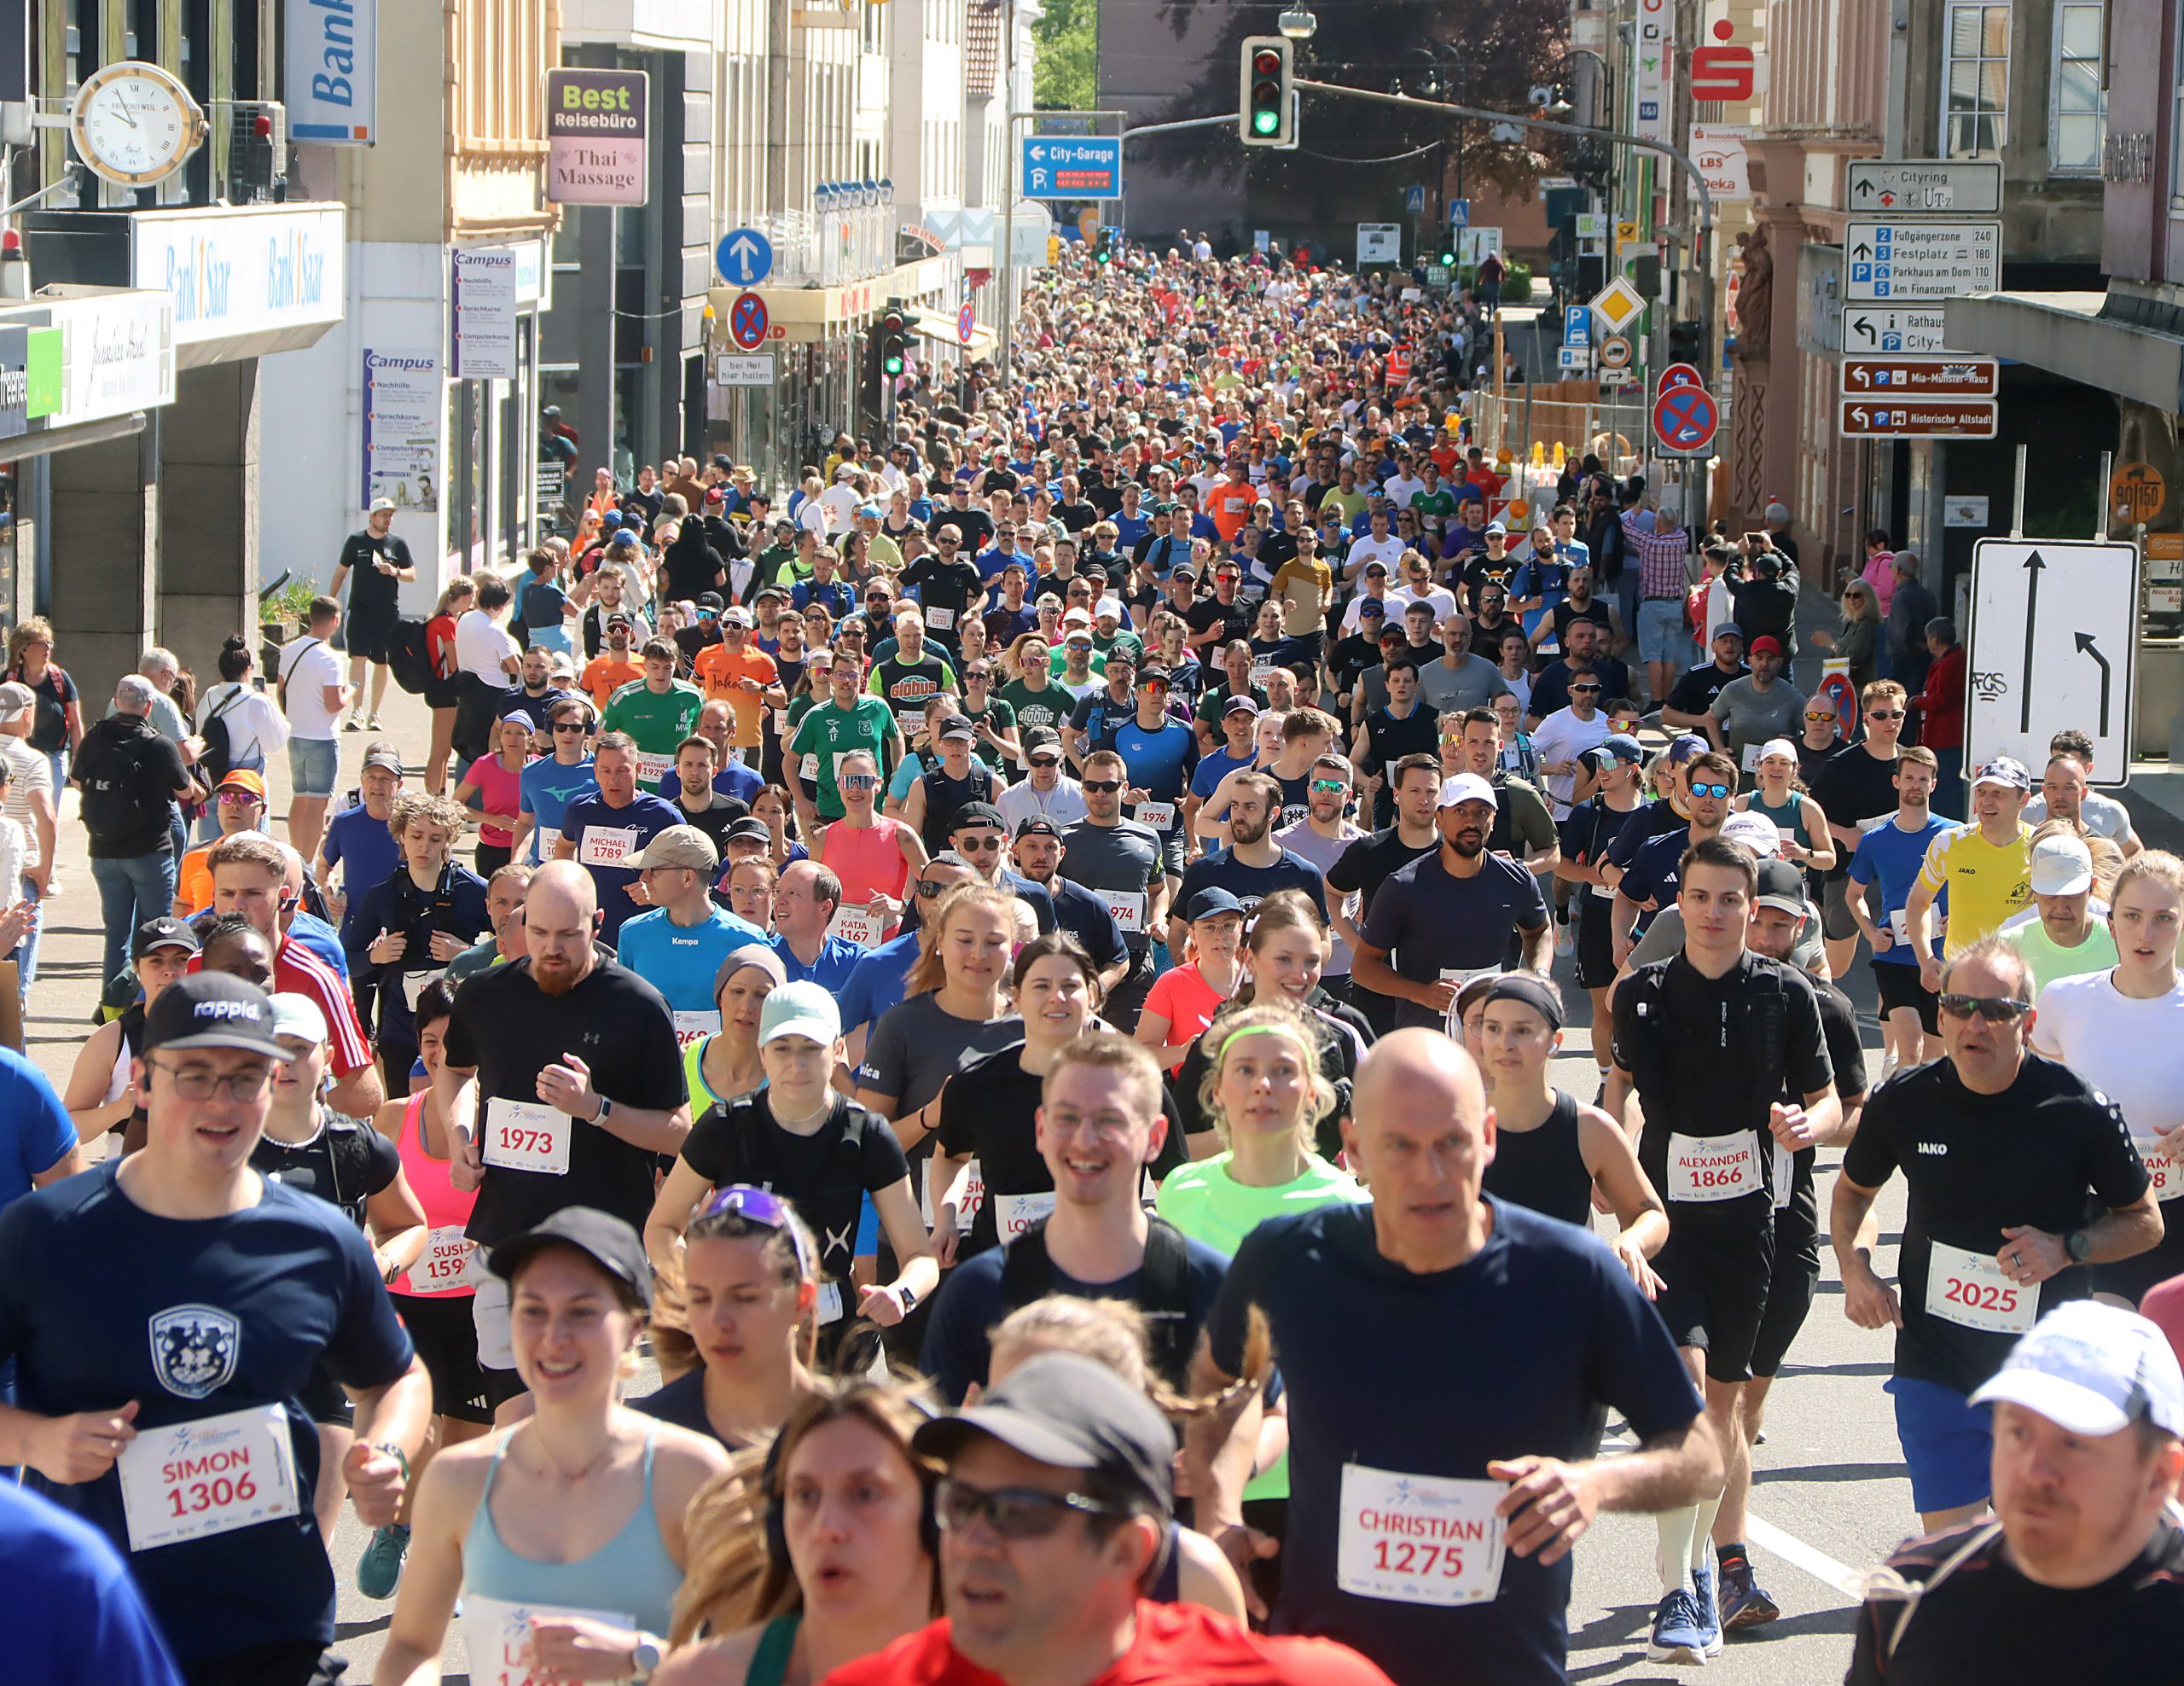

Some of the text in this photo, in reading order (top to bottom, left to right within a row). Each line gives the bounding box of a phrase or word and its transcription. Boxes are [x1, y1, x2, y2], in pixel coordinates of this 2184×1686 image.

[563, 85, 630, 110] Best
[141, 102, 155, 111] WEIL
[555, 113, 636, 129] Reisebüro
[575, 150, 616, 166] Thai
[1050, 146, 1113, 163] City-Garage
[1700, 158, 1723, 168] LBS
[558, 168, 636, 189] Massage
[1902, 172, 1948, 184] Cityring
[907, 226, 920, 235] EIS
[1894, 230, 1961, 244] Fußgängerzone
[1974, 231, 1991, 242] 240
[455, 254, 512, 268] Campus
[1894, 248, 1949, 260] Festplatz
[1975, 248, 1990, 259] 180
[268, 227, 294, 309] Bank
[301, 232, 323, 305] Saar
[1893, 267, 1935, 277] Parkhaus
[1937, 269, 1949, 277] am
[1951, 267, 1971, 277] Dom
[1976, 267, 1989, 277] 110
[166, 235, 196, 323] Bank
[206, 240, 230, 319] Saar
[1893, 285, 1908, 294] Am
[1912, 284, 1956, 294] Finanzamt
[1908, 334, 1945, 350] City-
[368, 354, 434, 372] Campus
[742, 371, 770, 380] halten
[1911, 413, 1956, 425] Historische
[1960, 414, 1993, 425] Altstadt
[2138, 486, 2158, 506] 150
[641, 760, 669, 769] MATHIAS
[1142, 811, 1167, 823] 1976
[590, 837, 627, 848] MICHAEL
[593, 846, 623, 859] 1789
[1958, 867, 1976, 875] JAKO
[840, 921, 868, 930] KATJA
[671, 937, 699, 946] Kempa
[839, 928, 869, 943] 1167
[500, 1126, 554, 1154] 1973
[1917, 1142, 1949, 1155] JAKO
[1678, 1150, 1749, 1169] ALEXANDER
[1690, 1166, 1743, 1189] 1866
[1945, 1278, 2018, 1313] 2025
[162, 1446, 250, 1484] SIMON
[166, 1470, 257, 1518] 1306
[1358, 1508, 1484, 1543] CHRISTIAN
[1373, 1538, 1464, 1578] 1275
